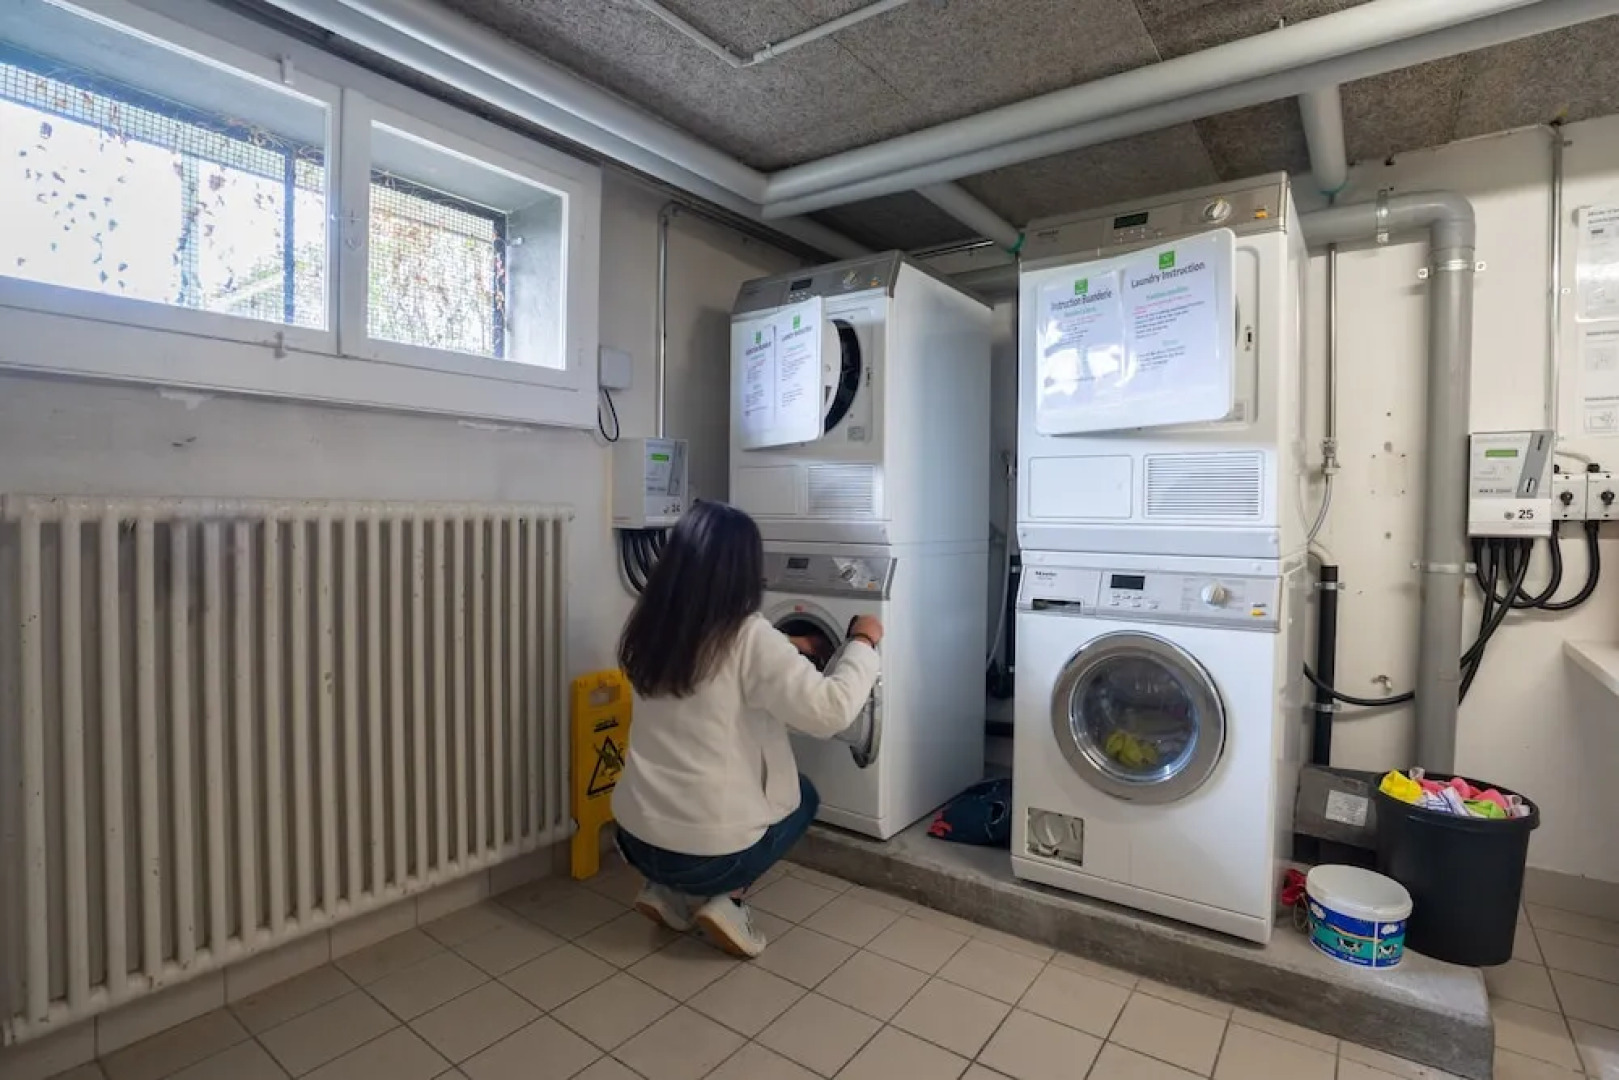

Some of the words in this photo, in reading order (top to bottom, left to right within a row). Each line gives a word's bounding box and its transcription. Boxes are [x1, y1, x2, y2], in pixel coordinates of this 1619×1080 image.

[1131, 273, 1160, 289] Laundry
[1162, 261, 1206, 280] Instruction
[1518, 509, 1535, 519] 25
